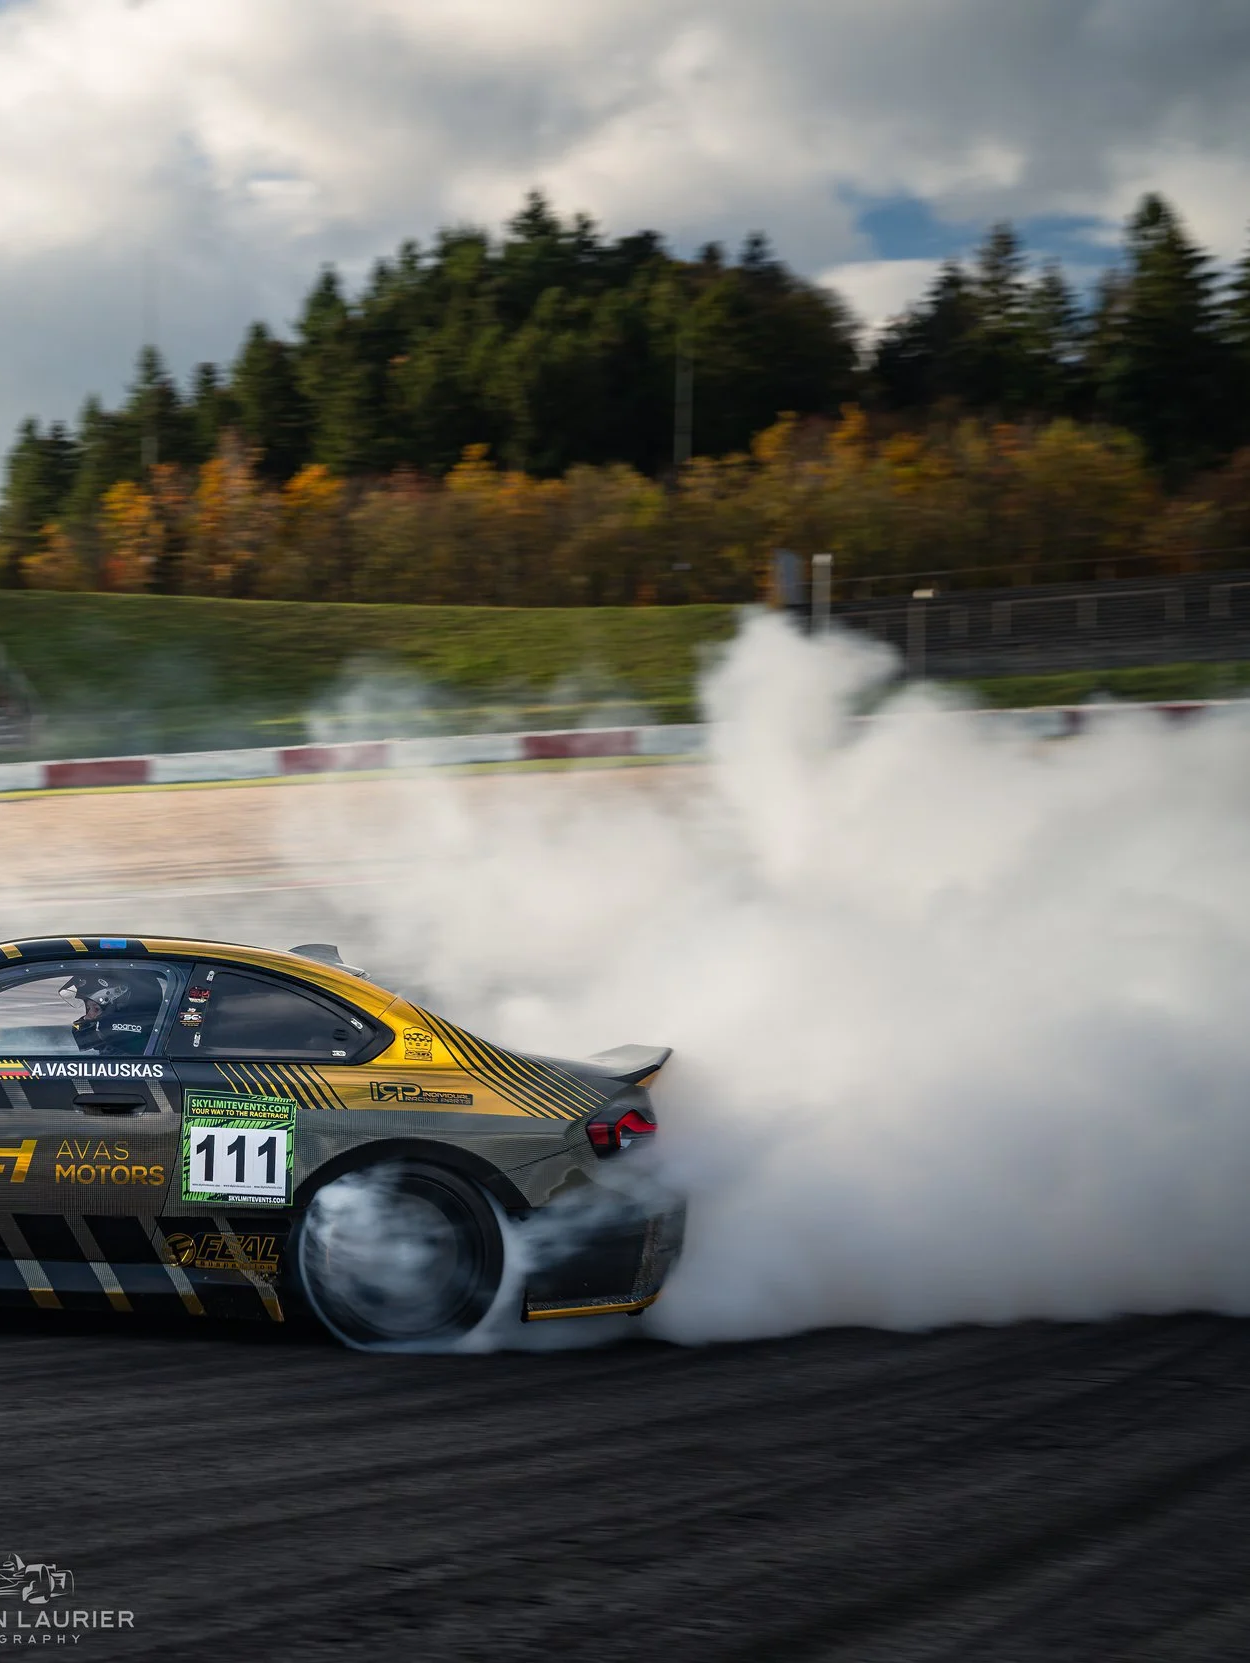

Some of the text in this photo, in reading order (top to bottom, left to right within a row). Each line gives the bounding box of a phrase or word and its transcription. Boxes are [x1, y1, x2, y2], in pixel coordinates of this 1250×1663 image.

[31, 1063, 163, 1077] A.VASILIAUSKAS
[191, 1099, 289, 1113] SKYLIMITEVENTS.COM
[249, 1111, 289, 1119] RACETRACK
[56, 1140, 129, 1161] AVAS
[196, 1134, 277, 1184] 111
[55, 1164, 165, 1186] MOTORS
[228, 1195, 286, 1204] SKYLIMITEVENTS.COM
[196, 1233, 280, 1263] FEAL
